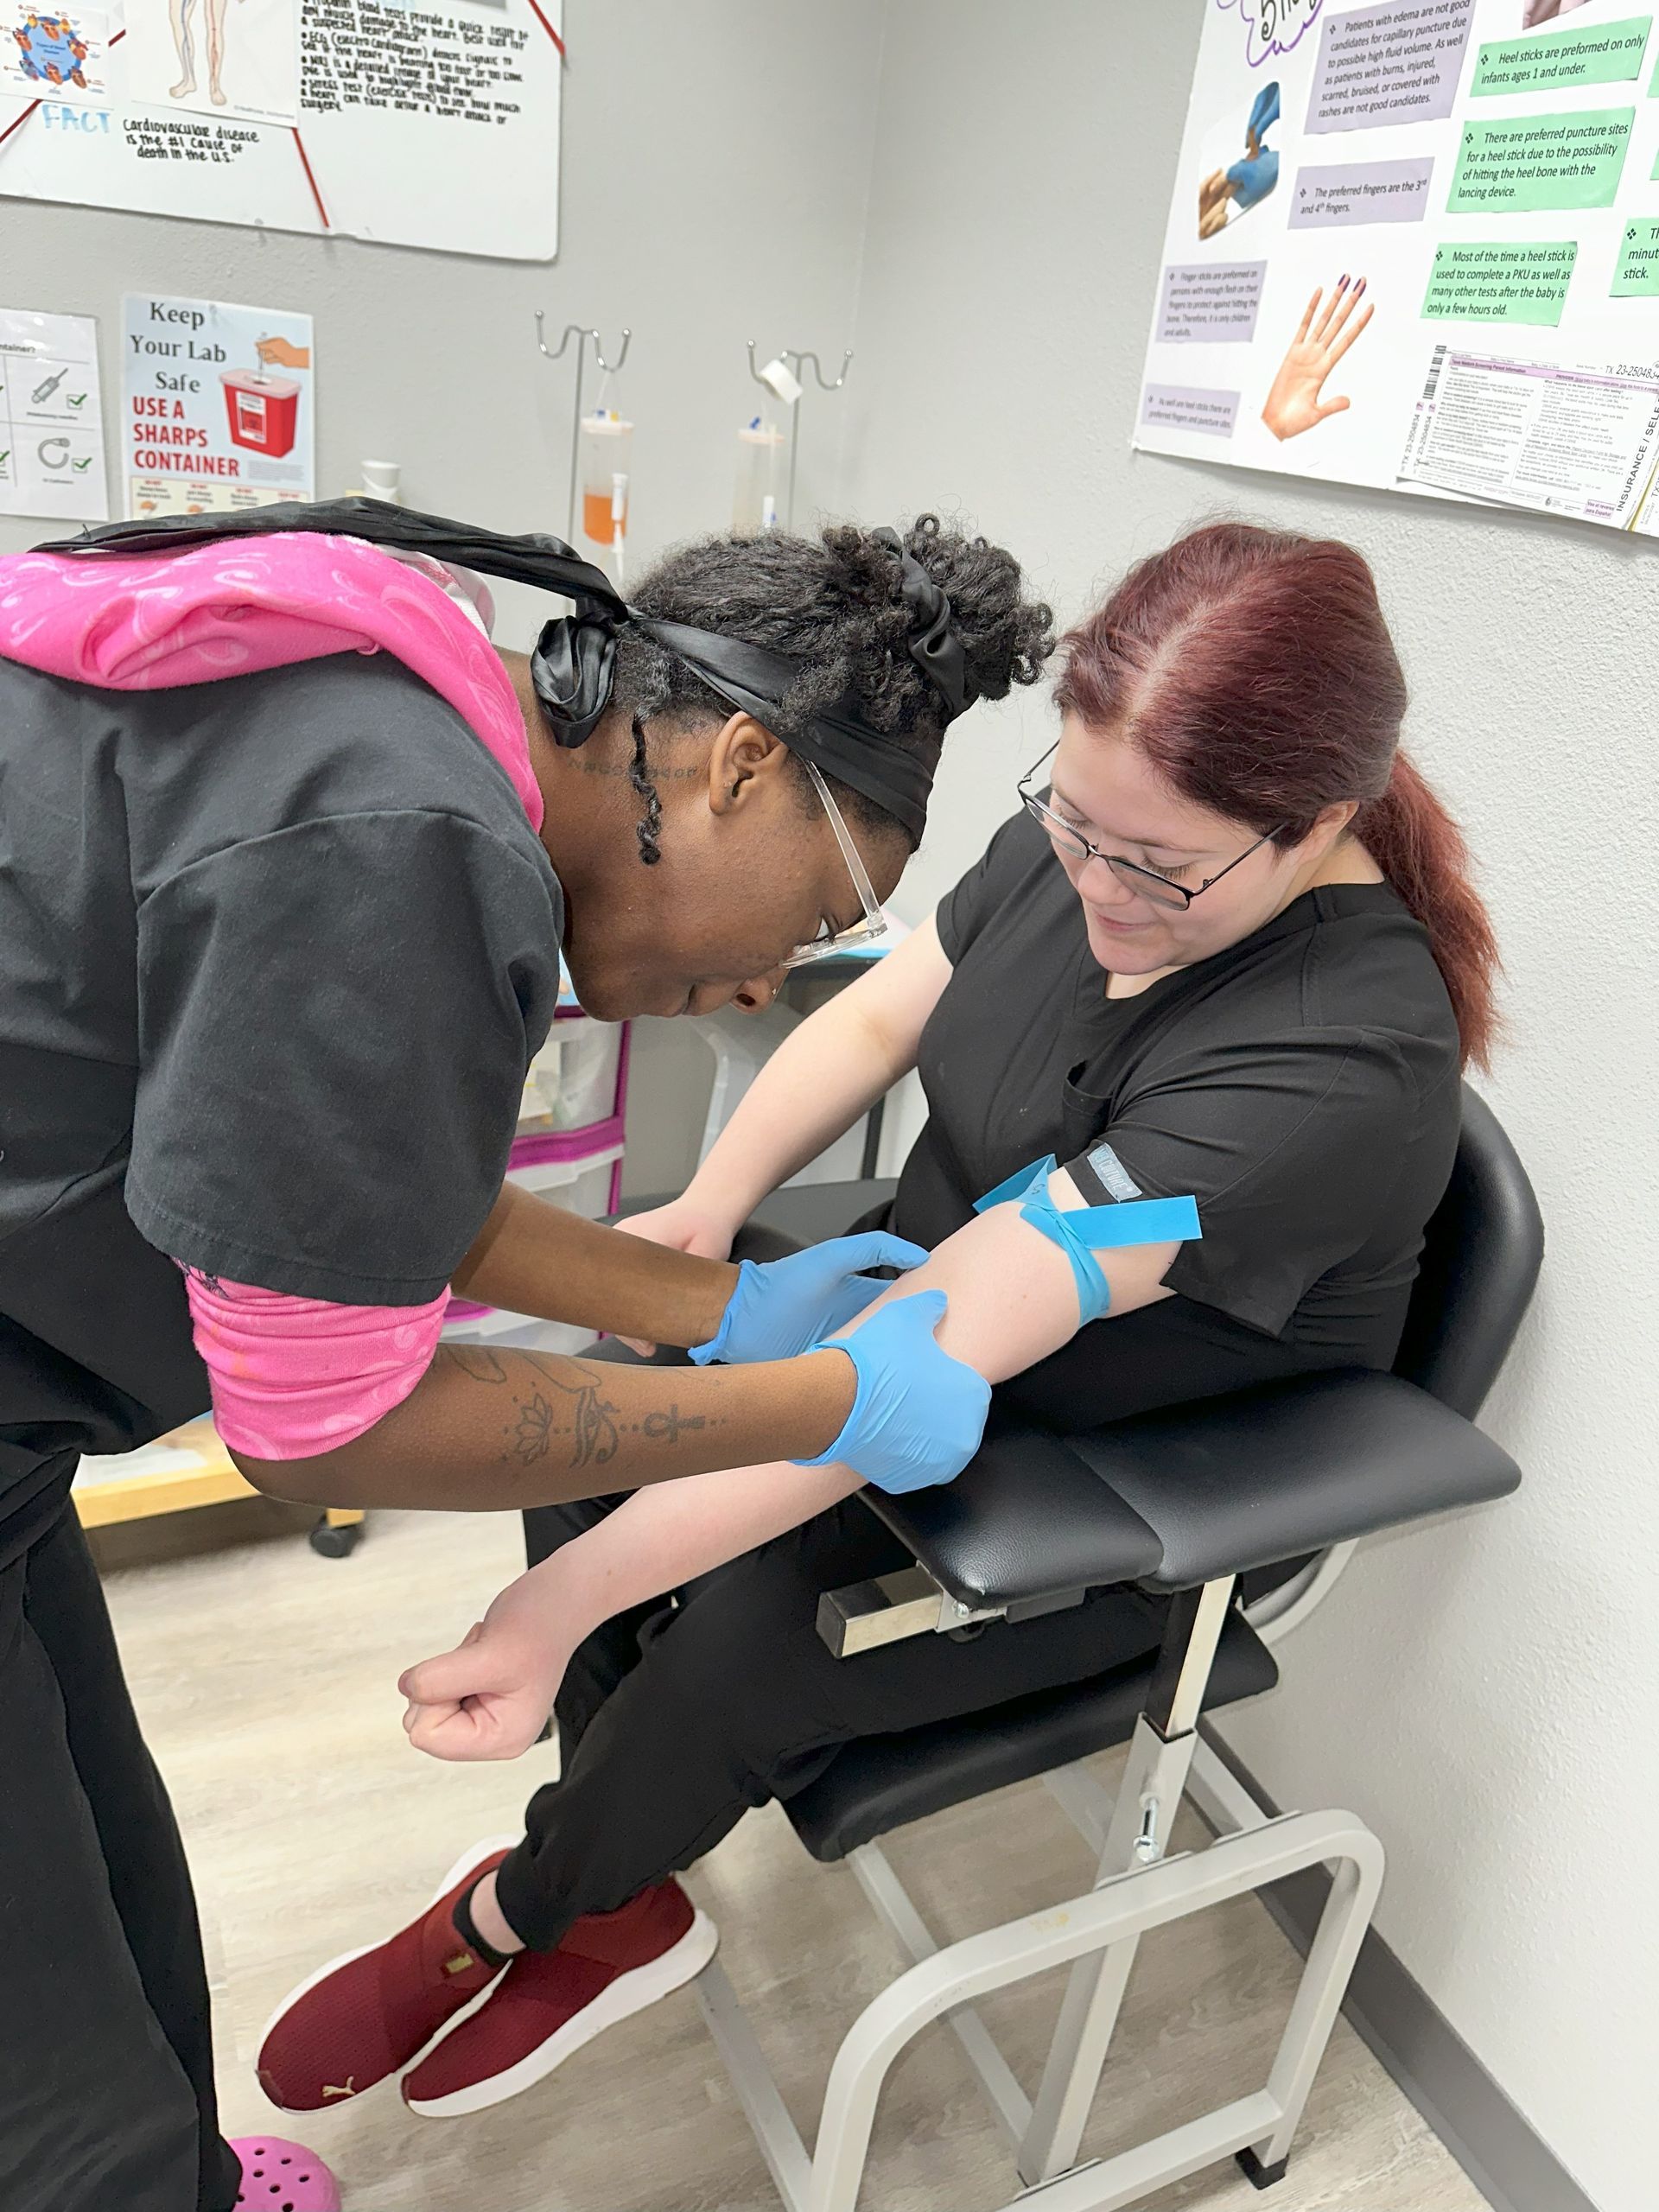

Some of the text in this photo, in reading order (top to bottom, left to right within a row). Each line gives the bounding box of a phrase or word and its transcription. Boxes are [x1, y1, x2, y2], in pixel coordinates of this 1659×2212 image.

[1344, 0, 1470, 33] Patients with edema are not good
[1331, 16, 1467, 52] candidates for capillary puncture due
[1328, 34, 1464, 68] to possible high fluid volume. As well
[1498, 34, 1645, 64] Heel sticks are preformed on only
[1325, 57, 1436, 86] as patients with burns, injured,
[1481, 62, 1586, 84] infants ages 1 and under.
[1321, 73, 1440, 102] scarred, bruised, or covered with
[1319, 93, 1431, 118] rashes are not good candidates.
[41, 104, 111, 133] FACT
[139, 134, 162, 146] the
[168, 136, 185, 148] #1
[216, 126, 260, 143] disease
[1484, 123, 1629, 144] There are preferred puncture sites
[185, 149, 207, 162] the
[1466, 143, 1618, 162] for a heel stick due to the possibility
[1462, 162, 1596, 181] of hitting the heel bone with the
[1314, 187, 1327, 198] The
[1328, 184, 1362, 200] preferred
[1363, 181, 1387, 196] fingers
[1388, 183, 1401, 193] are
[1402, 181, 1414, 192] the
[1458, 186, 1516, 200] lancing device.
[1300, 204, 1314, 214] and
[1325, 202, 1350, 215] fingers.
[1452, 250, 1575, 262] Most of the time a heel stick is
[1436, 269, 1571, 282] used to complete a PKU as well as
[1623, 266, 1649, 279] stick.
[1432, 286, 1565, 301] many other tests after the baby is
[149, 302, 205, 331] Keep
[1427, 302, 1507, 315] only a few hours old.
[130, 335, 226, 363] Your Lab
[1605, 365, 1613, 375] TX
[156, 372, 200, 393] Safe
[133, 396, 185, 419] USE A
[133, 423, 208, 448] SHARPS
[135, 450, 240, 476] CONTAINER
[1616, 445, 1648, 512] INSURANCE
